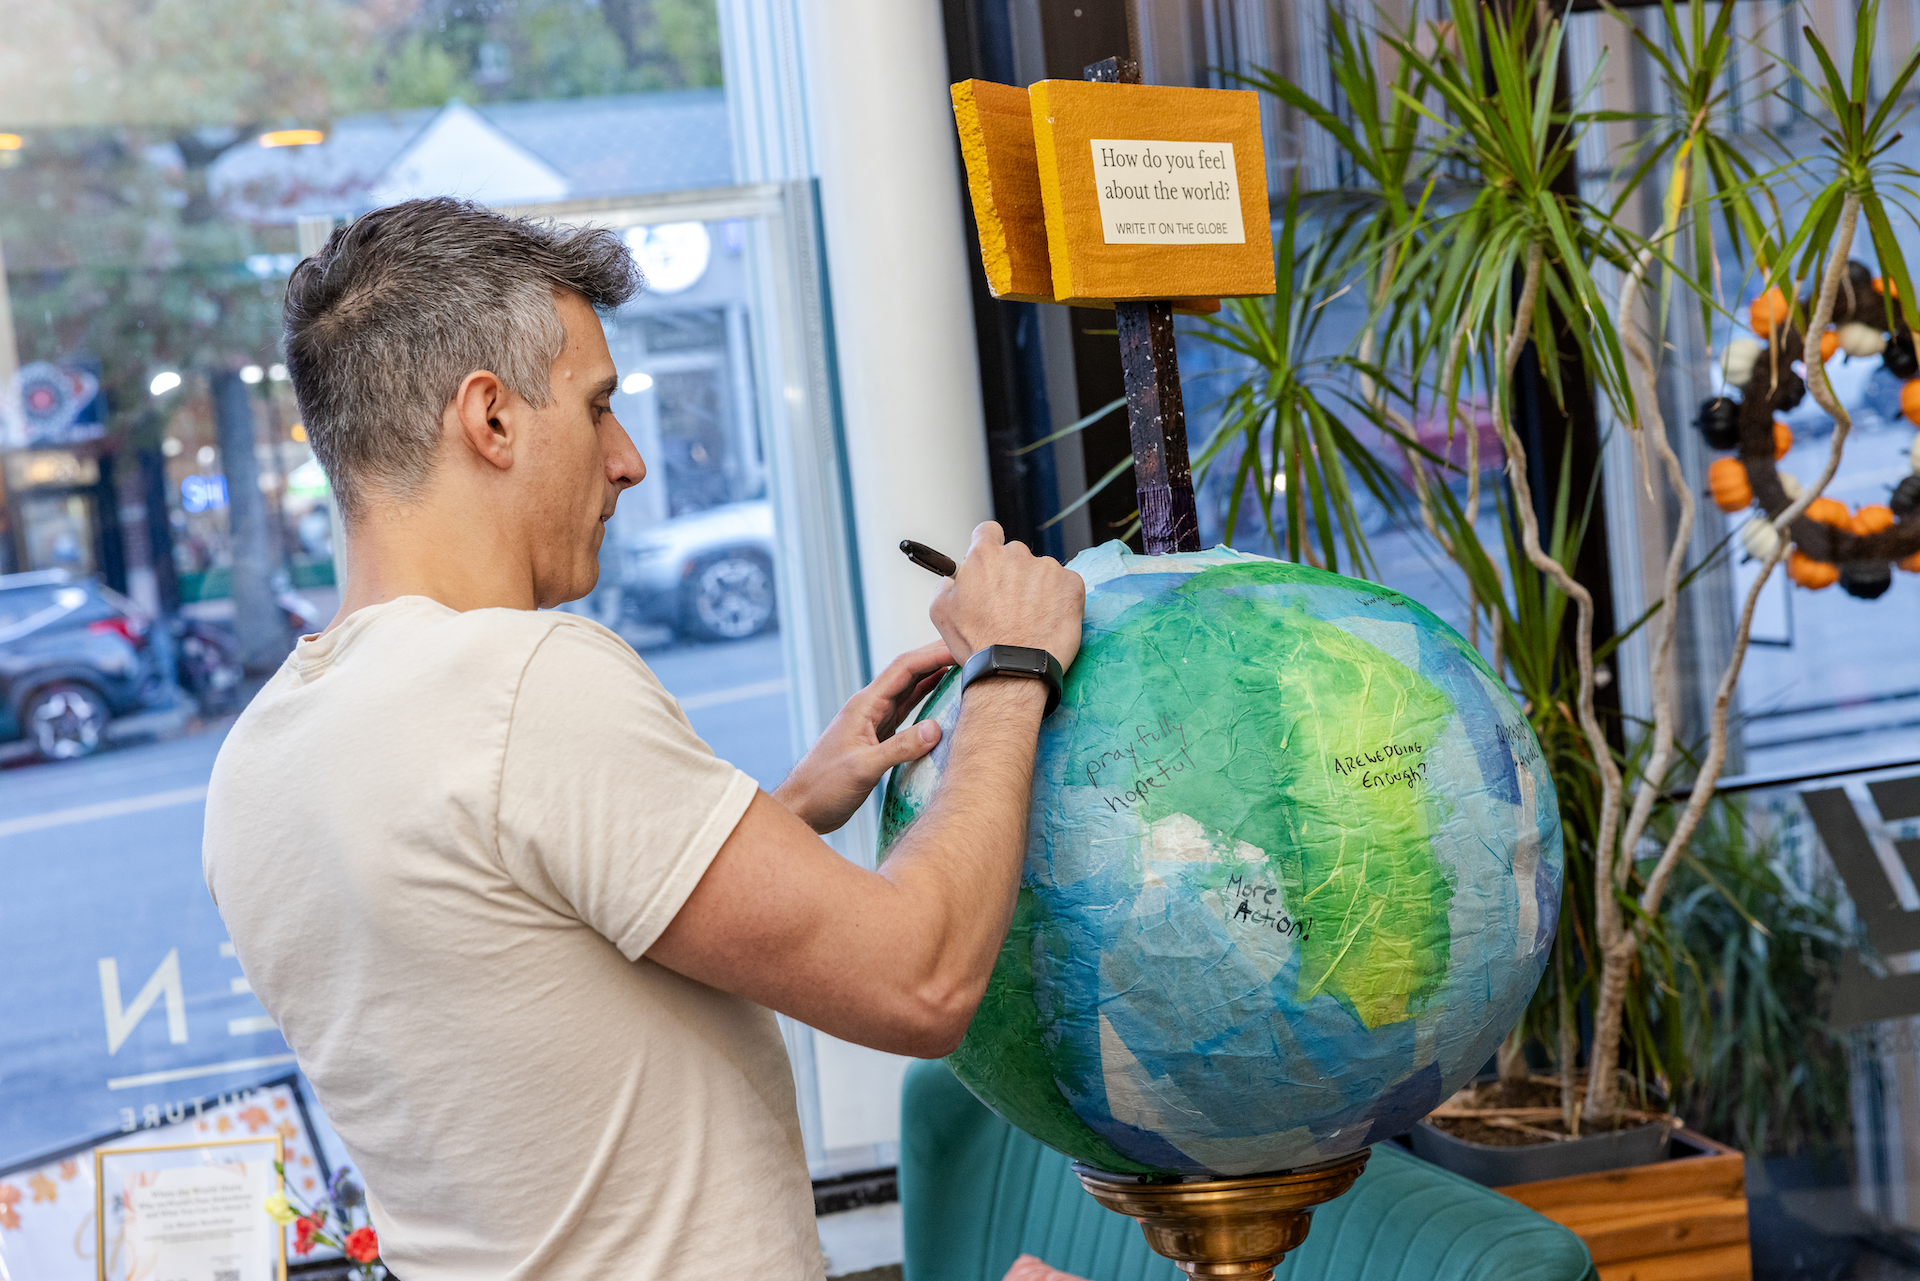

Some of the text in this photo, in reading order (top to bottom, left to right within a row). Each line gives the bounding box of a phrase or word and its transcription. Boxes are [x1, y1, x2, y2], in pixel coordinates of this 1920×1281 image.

[1100, 148, 1227, 174] How do you feel
[1105, 179, 1230, 200] about the world?
[1115, 222, 1229, 235] WRITE IT ON THE GLOBE
[1103, 747, 1197, 813] hopeful
[1226, 873, 1278, 905] More
[1233, 899, 1313, 941] Action!
